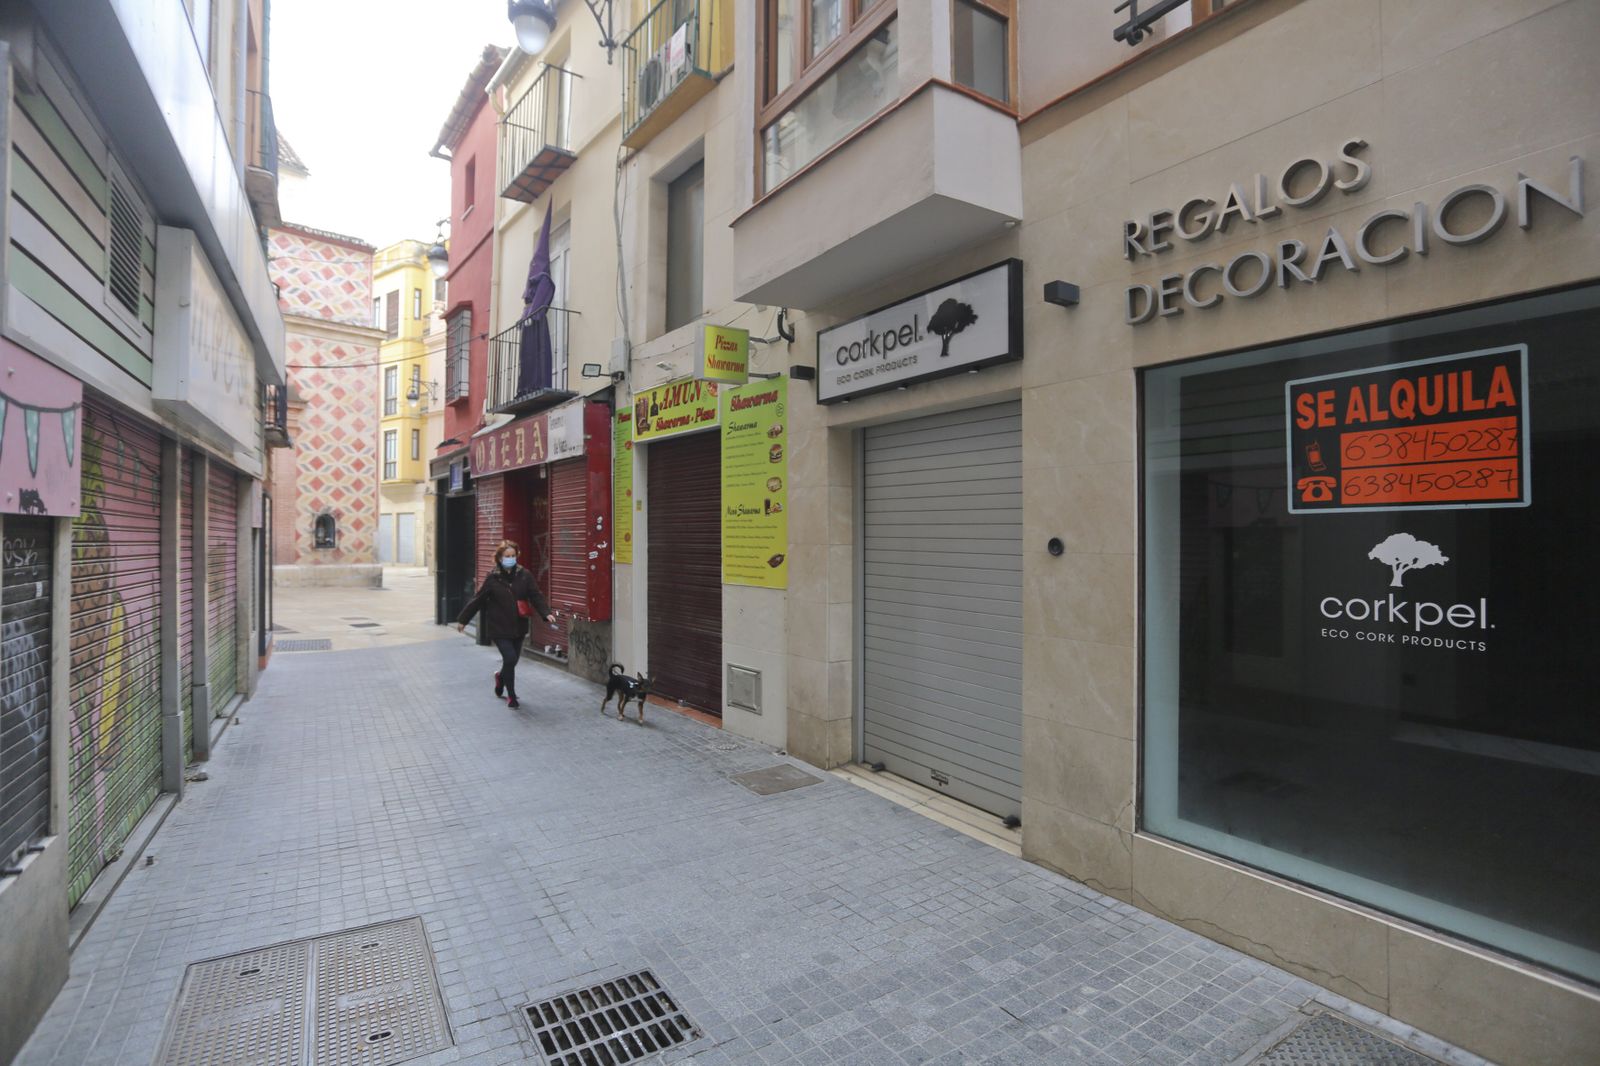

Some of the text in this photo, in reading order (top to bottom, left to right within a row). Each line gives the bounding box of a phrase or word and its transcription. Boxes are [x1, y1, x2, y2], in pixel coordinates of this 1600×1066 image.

[1123, 136, 1372, 261] REGALOS
[1124, 155, 1585, 327] DECORACION
[706, 353, 745, 373] Shawarma
[836, 355, 918, 385] ECO CORK PRODUCTS
[659, 380, 703, 411] AMUN
[731, 390, 779, 412] Shawarma
[1296, 365, 1517, 430] SE ALQUILA
[656, 414, 690, 431] Shawarma
[1345, 427, 1519, 462] 638450287
[1344, 468, 1519, 497] 638450287
[1321, 628, 1487, 652] ECO CORK PRODUCTS
